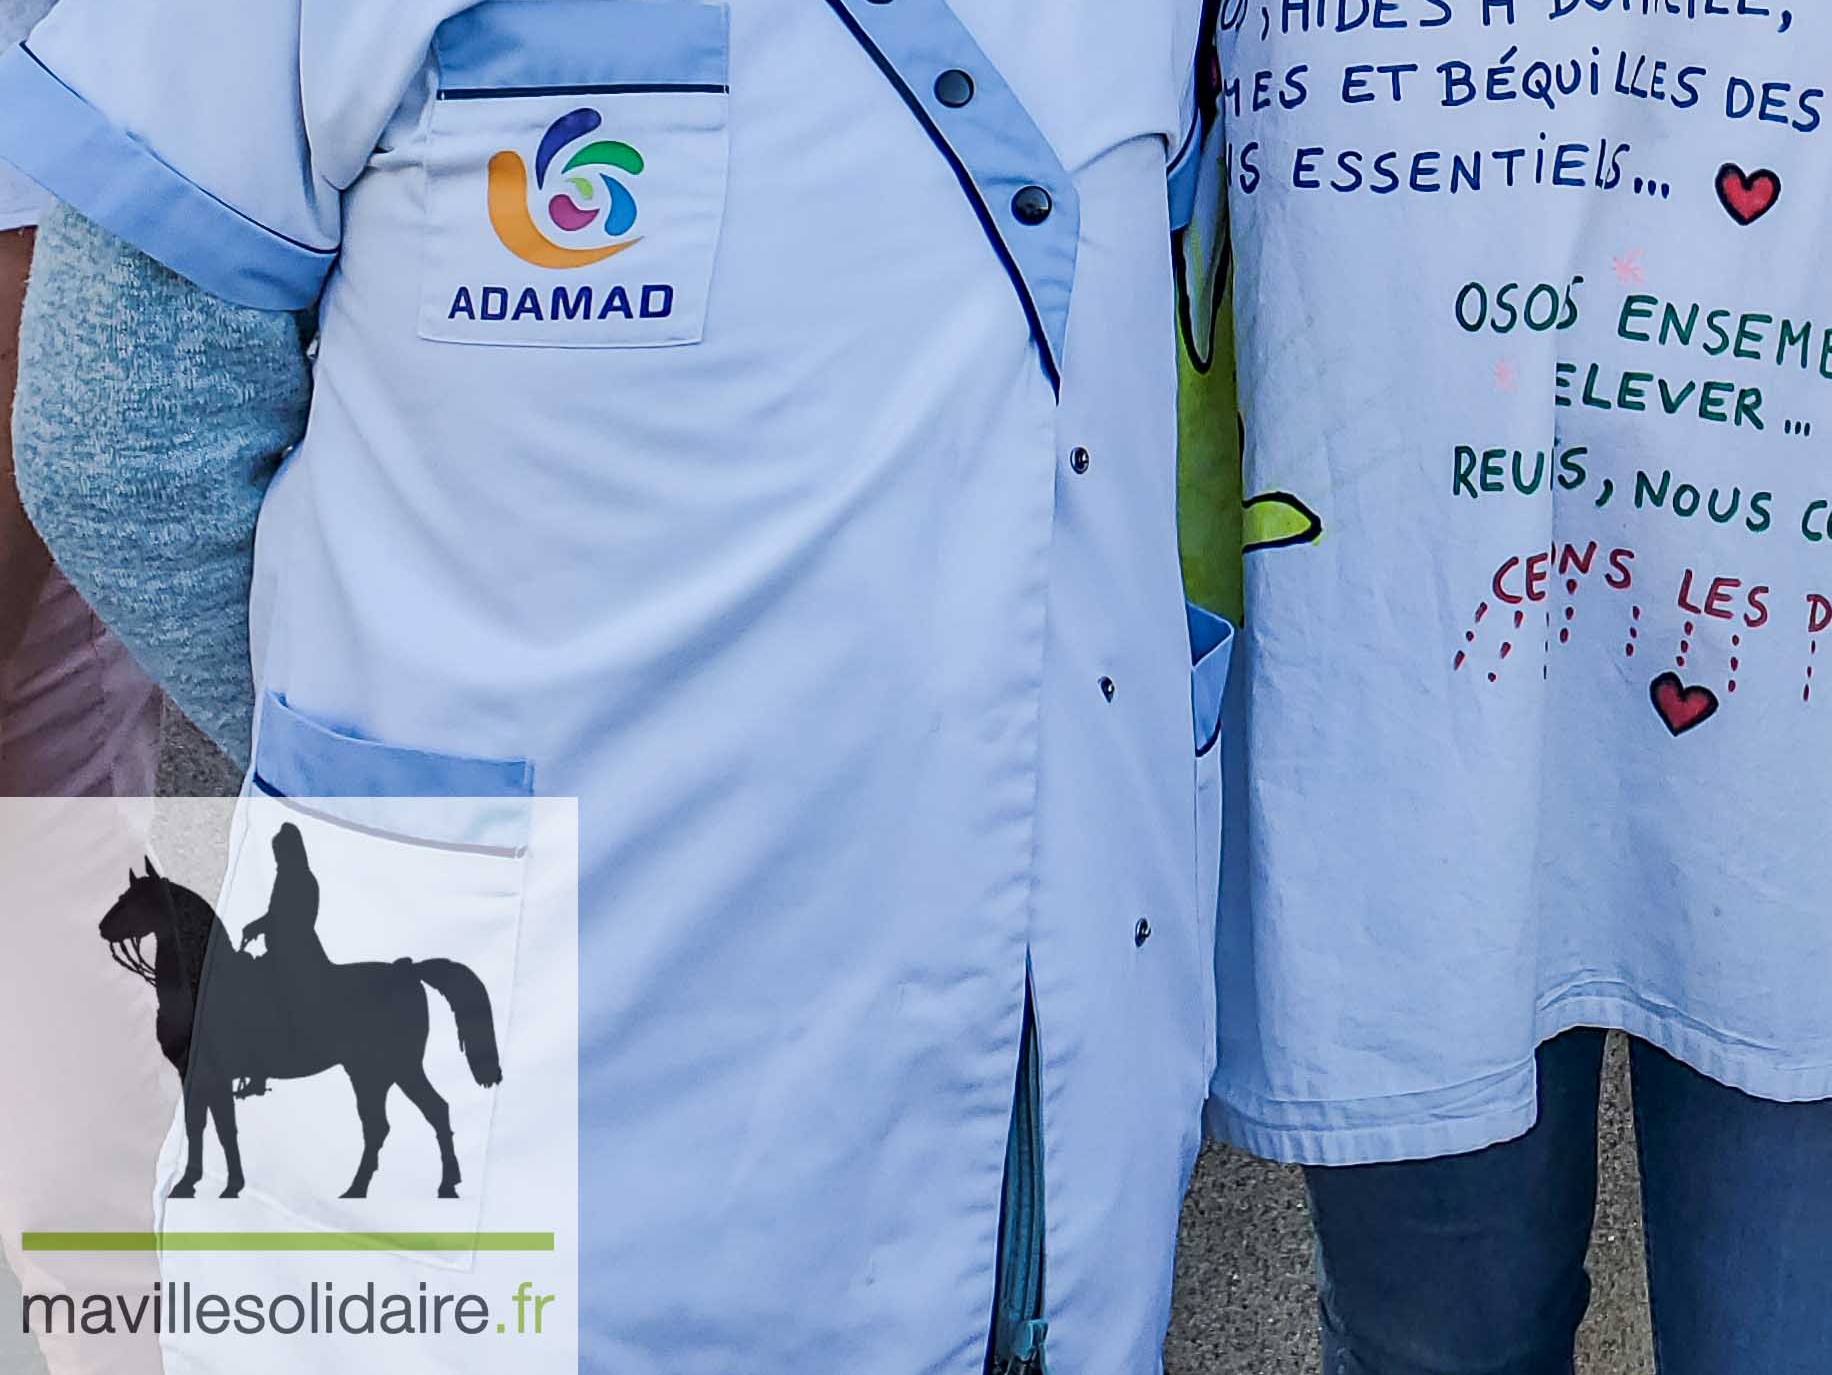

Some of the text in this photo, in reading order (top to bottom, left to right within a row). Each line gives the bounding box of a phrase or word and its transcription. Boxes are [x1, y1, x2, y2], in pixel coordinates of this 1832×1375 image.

[1341, 62, 1418, 104] ET
[1725, 76, 1825, 132] DES
[447, 284, 674, 321] ADAMAD
[1634, 469, 1773, 533] NOUS
[1677, 568, 1771, 628] LES
